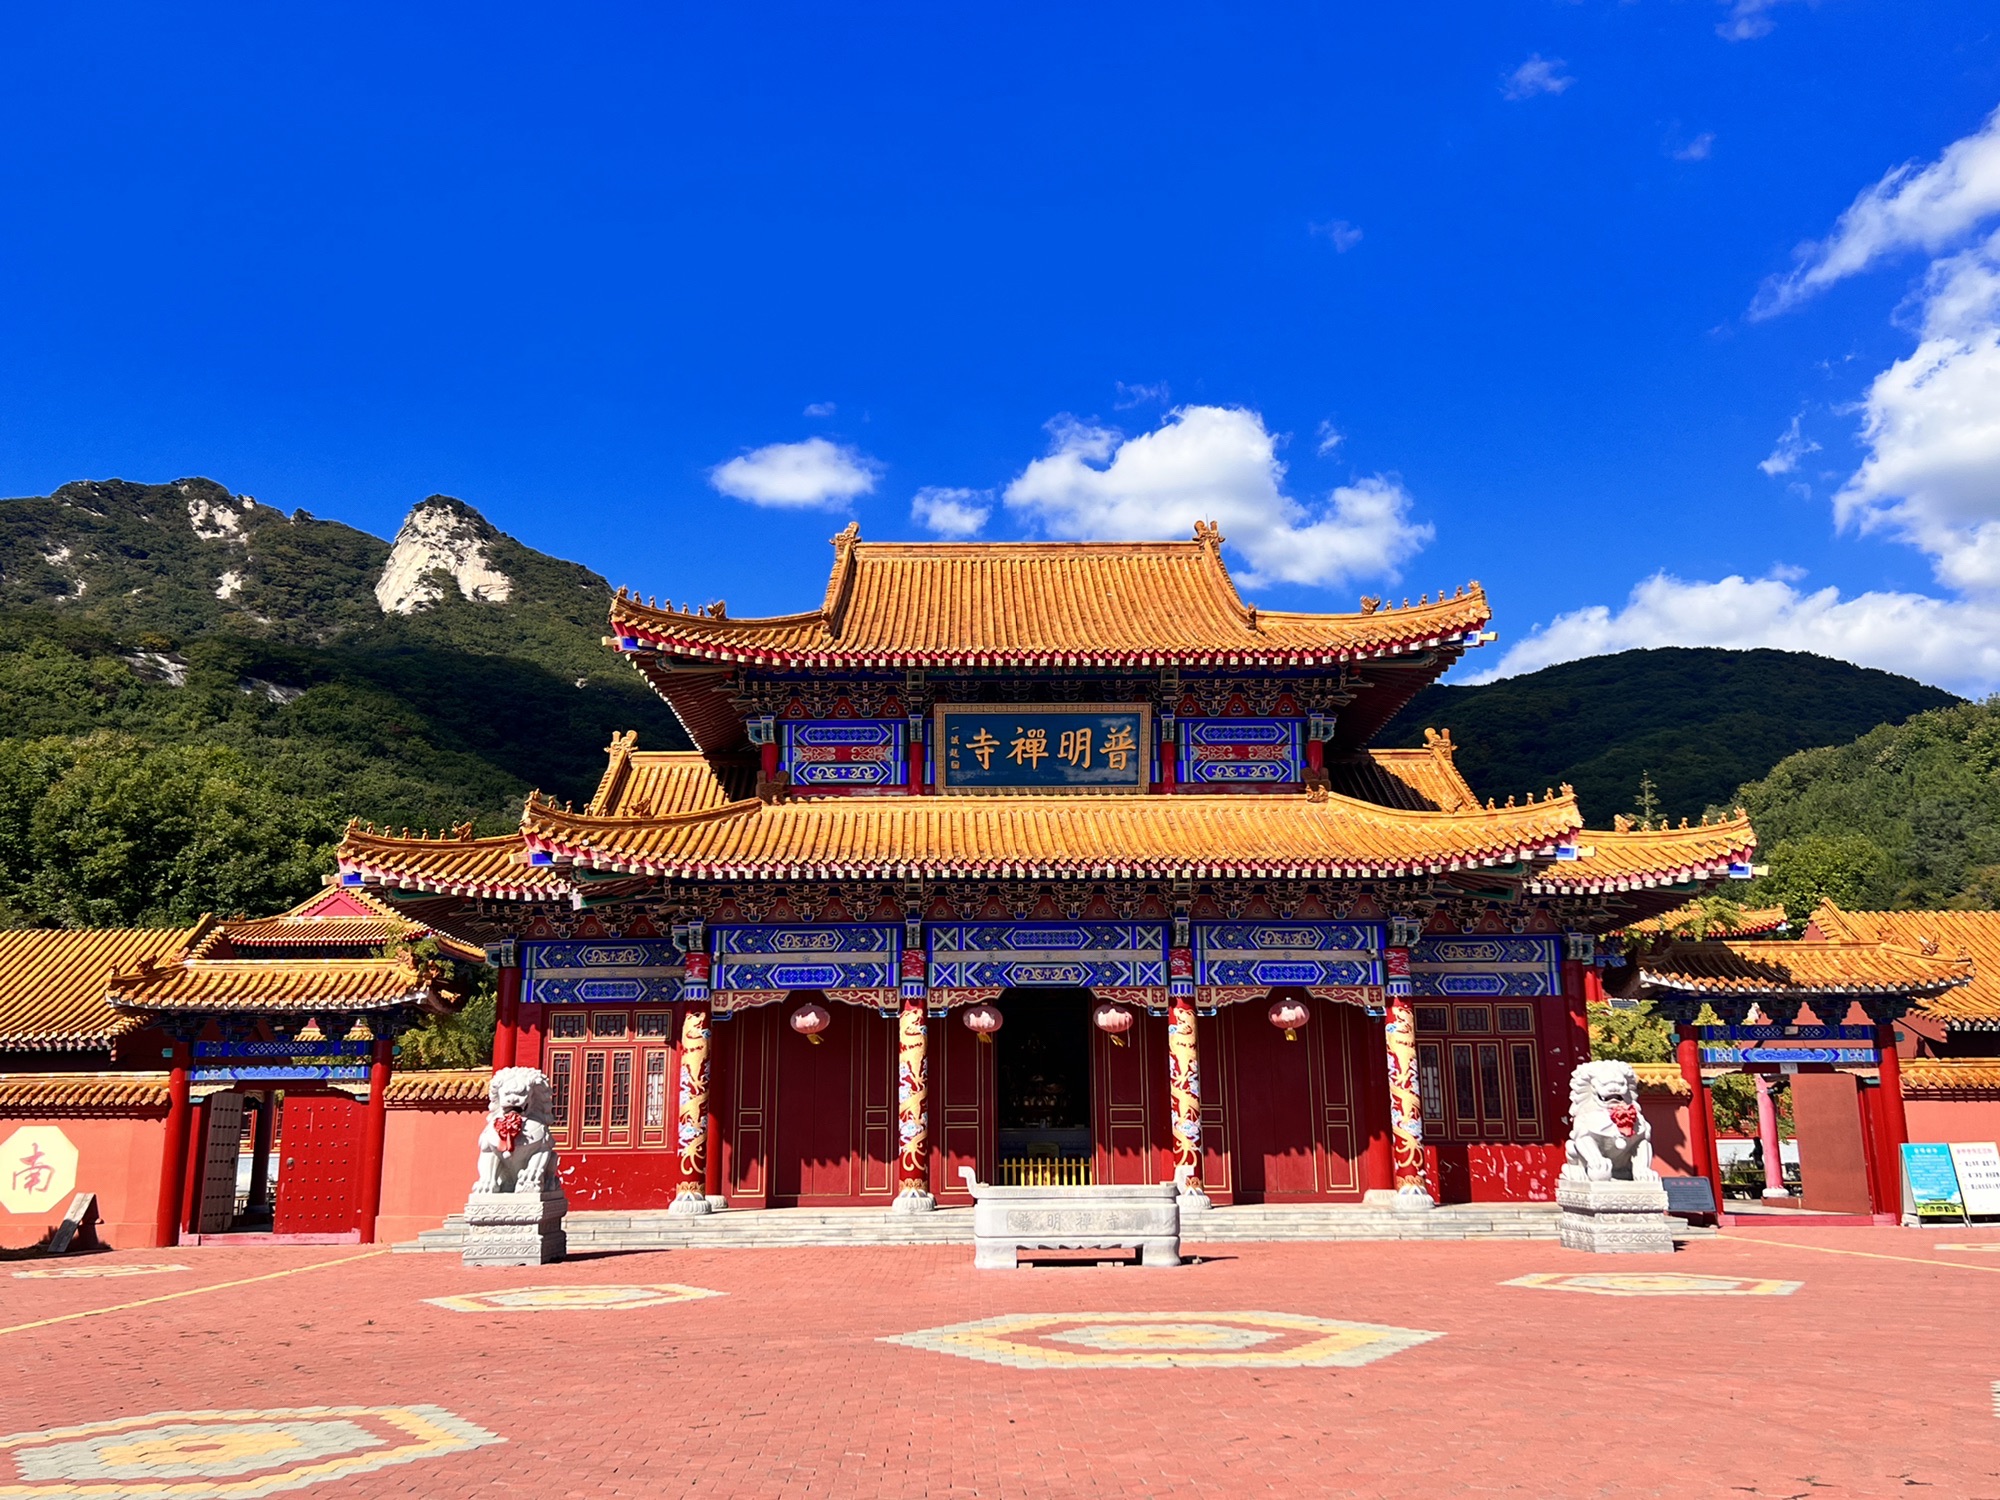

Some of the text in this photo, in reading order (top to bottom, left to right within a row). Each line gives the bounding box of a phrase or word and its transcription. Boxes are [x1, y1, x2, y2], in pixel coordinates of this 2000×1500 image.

[965, 724, 1137, 771] 普明禪寺
[12, 1142, 55, 1195] 南
